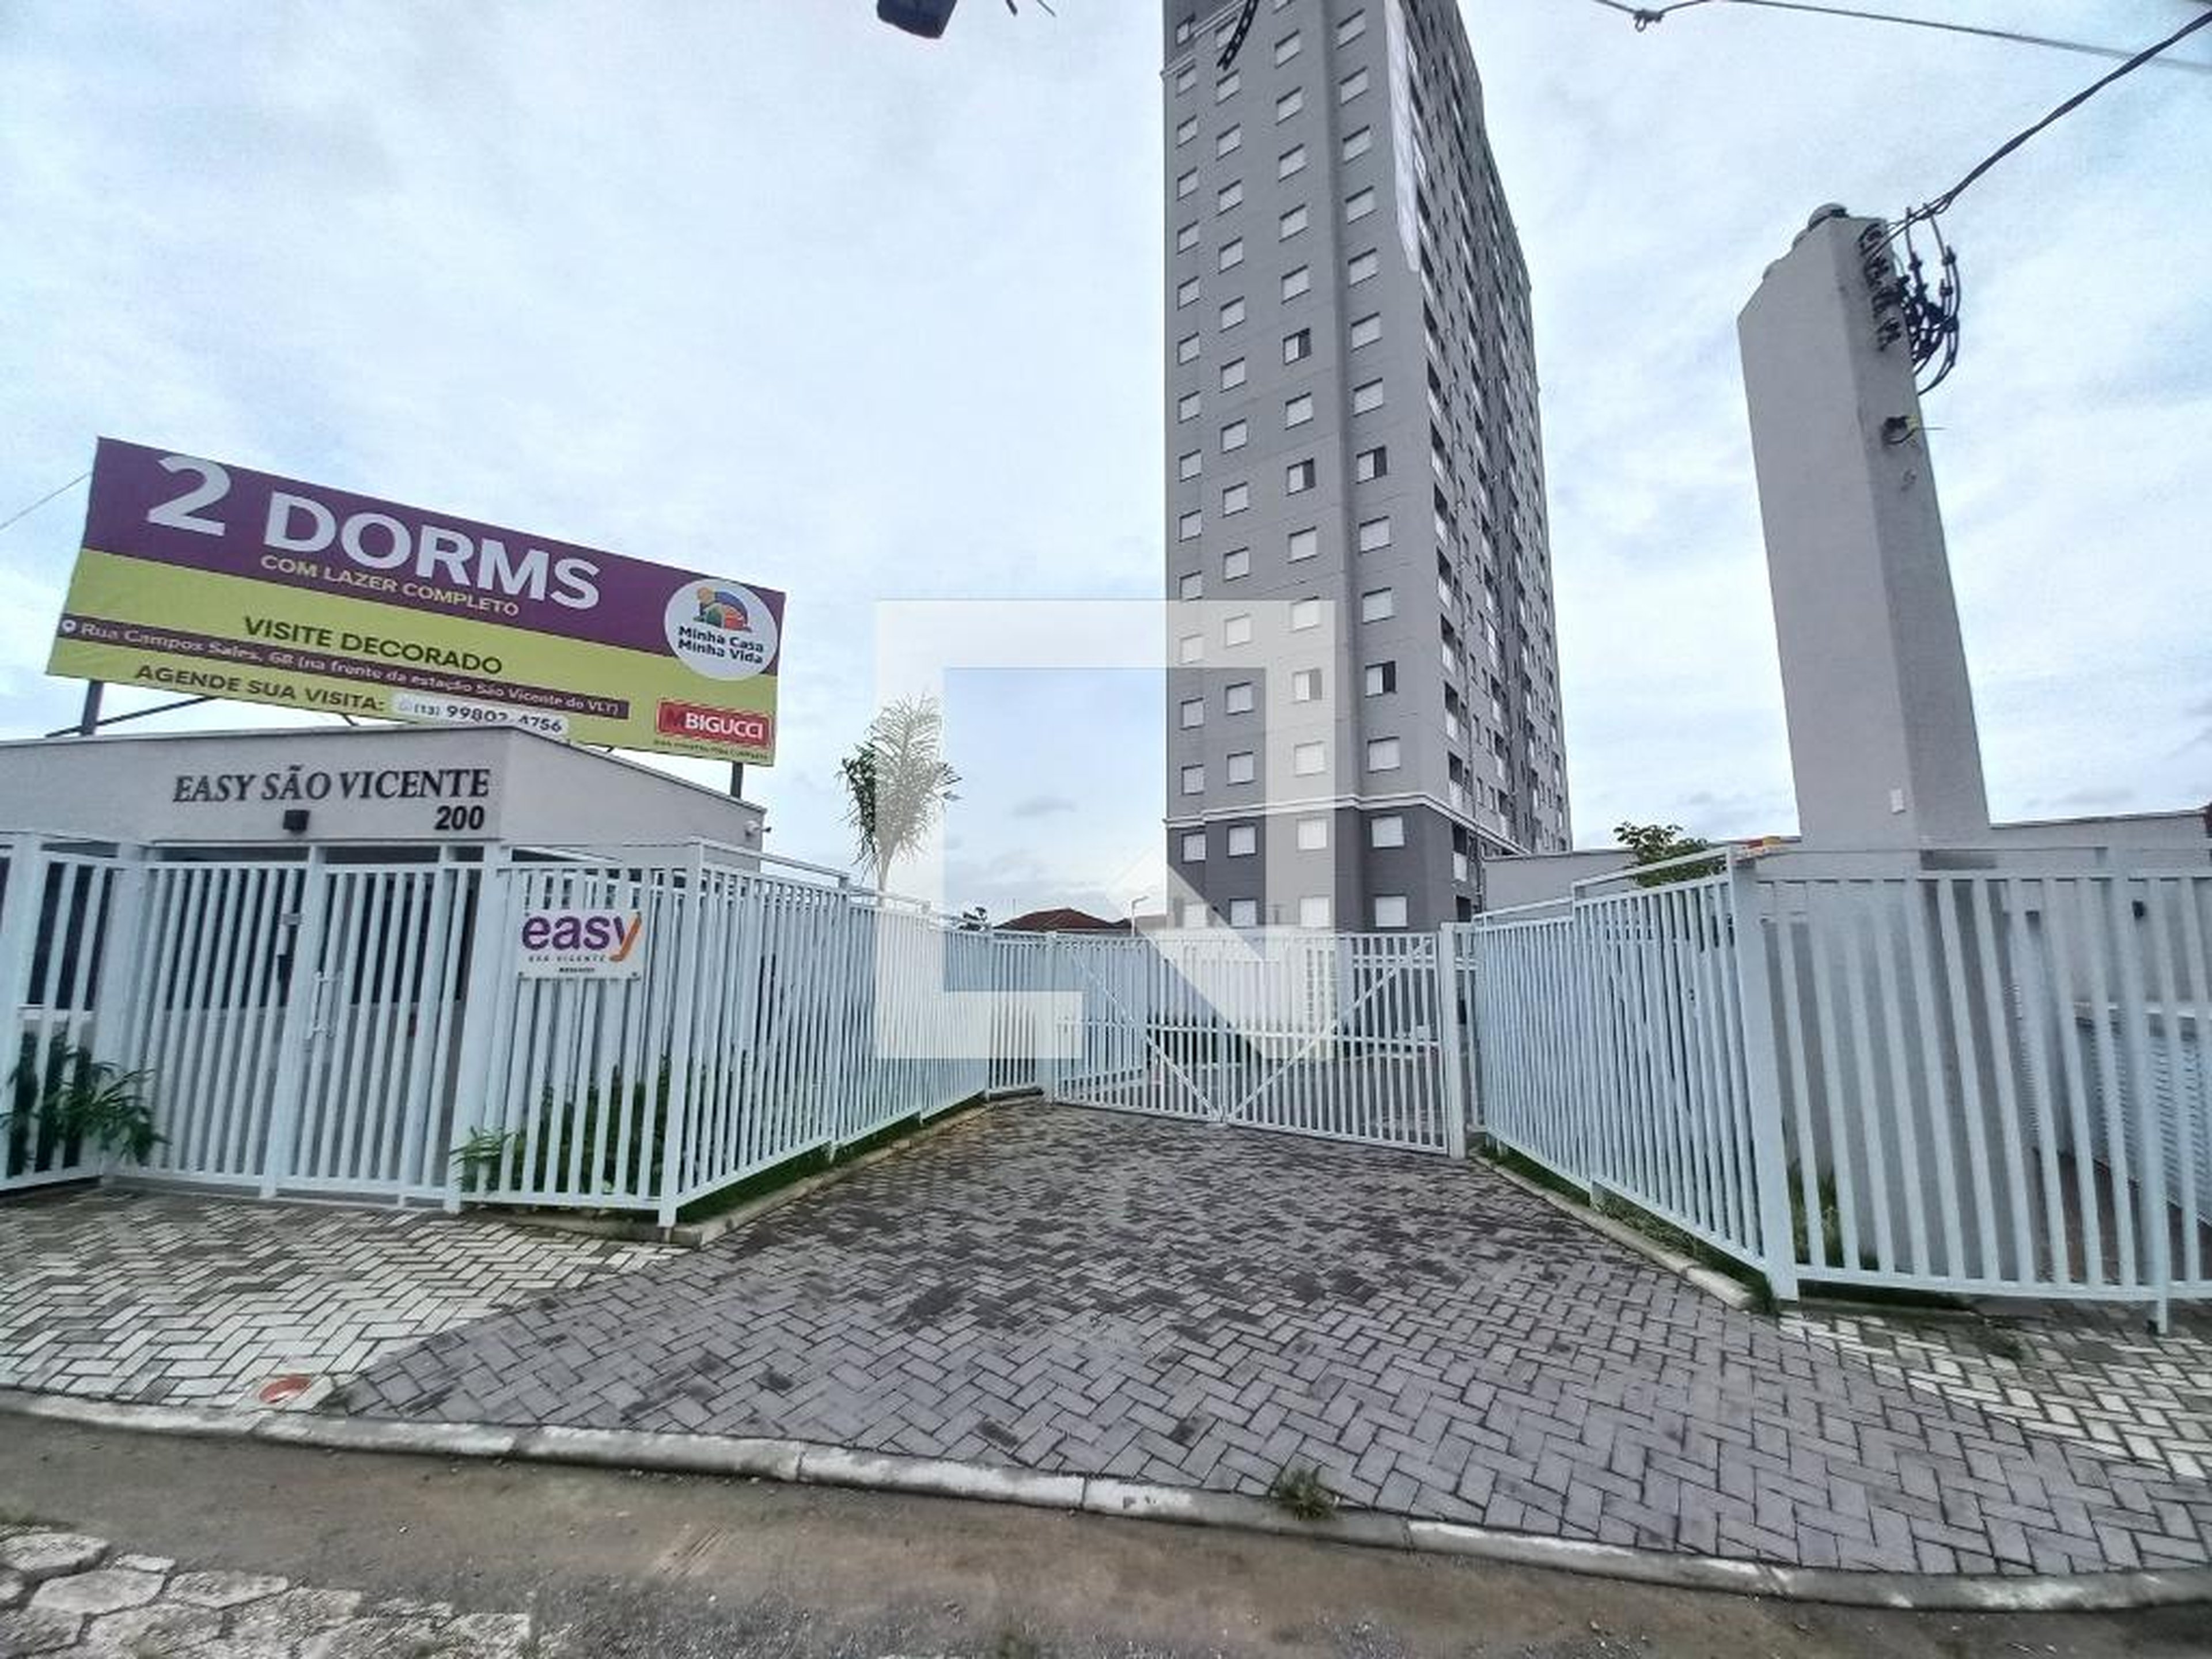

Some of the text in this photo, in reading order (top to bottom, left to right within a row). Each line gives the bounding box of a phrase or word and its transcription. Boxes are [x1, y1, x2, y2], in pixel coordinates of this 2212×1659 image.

[147, 455, 600, 609] 2 DORMS
[261, 555, 519, 617] COM LAZER COMPLETO
[245, 616, 502, 674] VISITE DECORADO
[678, 639, 763, 664] Minha Vida
[679, 626, 764, 653] Minha Casa
[81, 623, 119, 640] Rua
[124, 630, 204, 651] Campos
[385, 669, 407, 682] da
[509, 688, 563, 705] Vicente
[566, 697, 584, 709] do
[135, 665, 240, 692] AGENDE
[248, 679, 296, 700] SUA
[305, 688, 386, 712] VISITA:
[173, 764, 491, 802] EASY SÃO VICENTE
[433, 805, 484, 831] 200
[522, 911, 642, 962] easy
